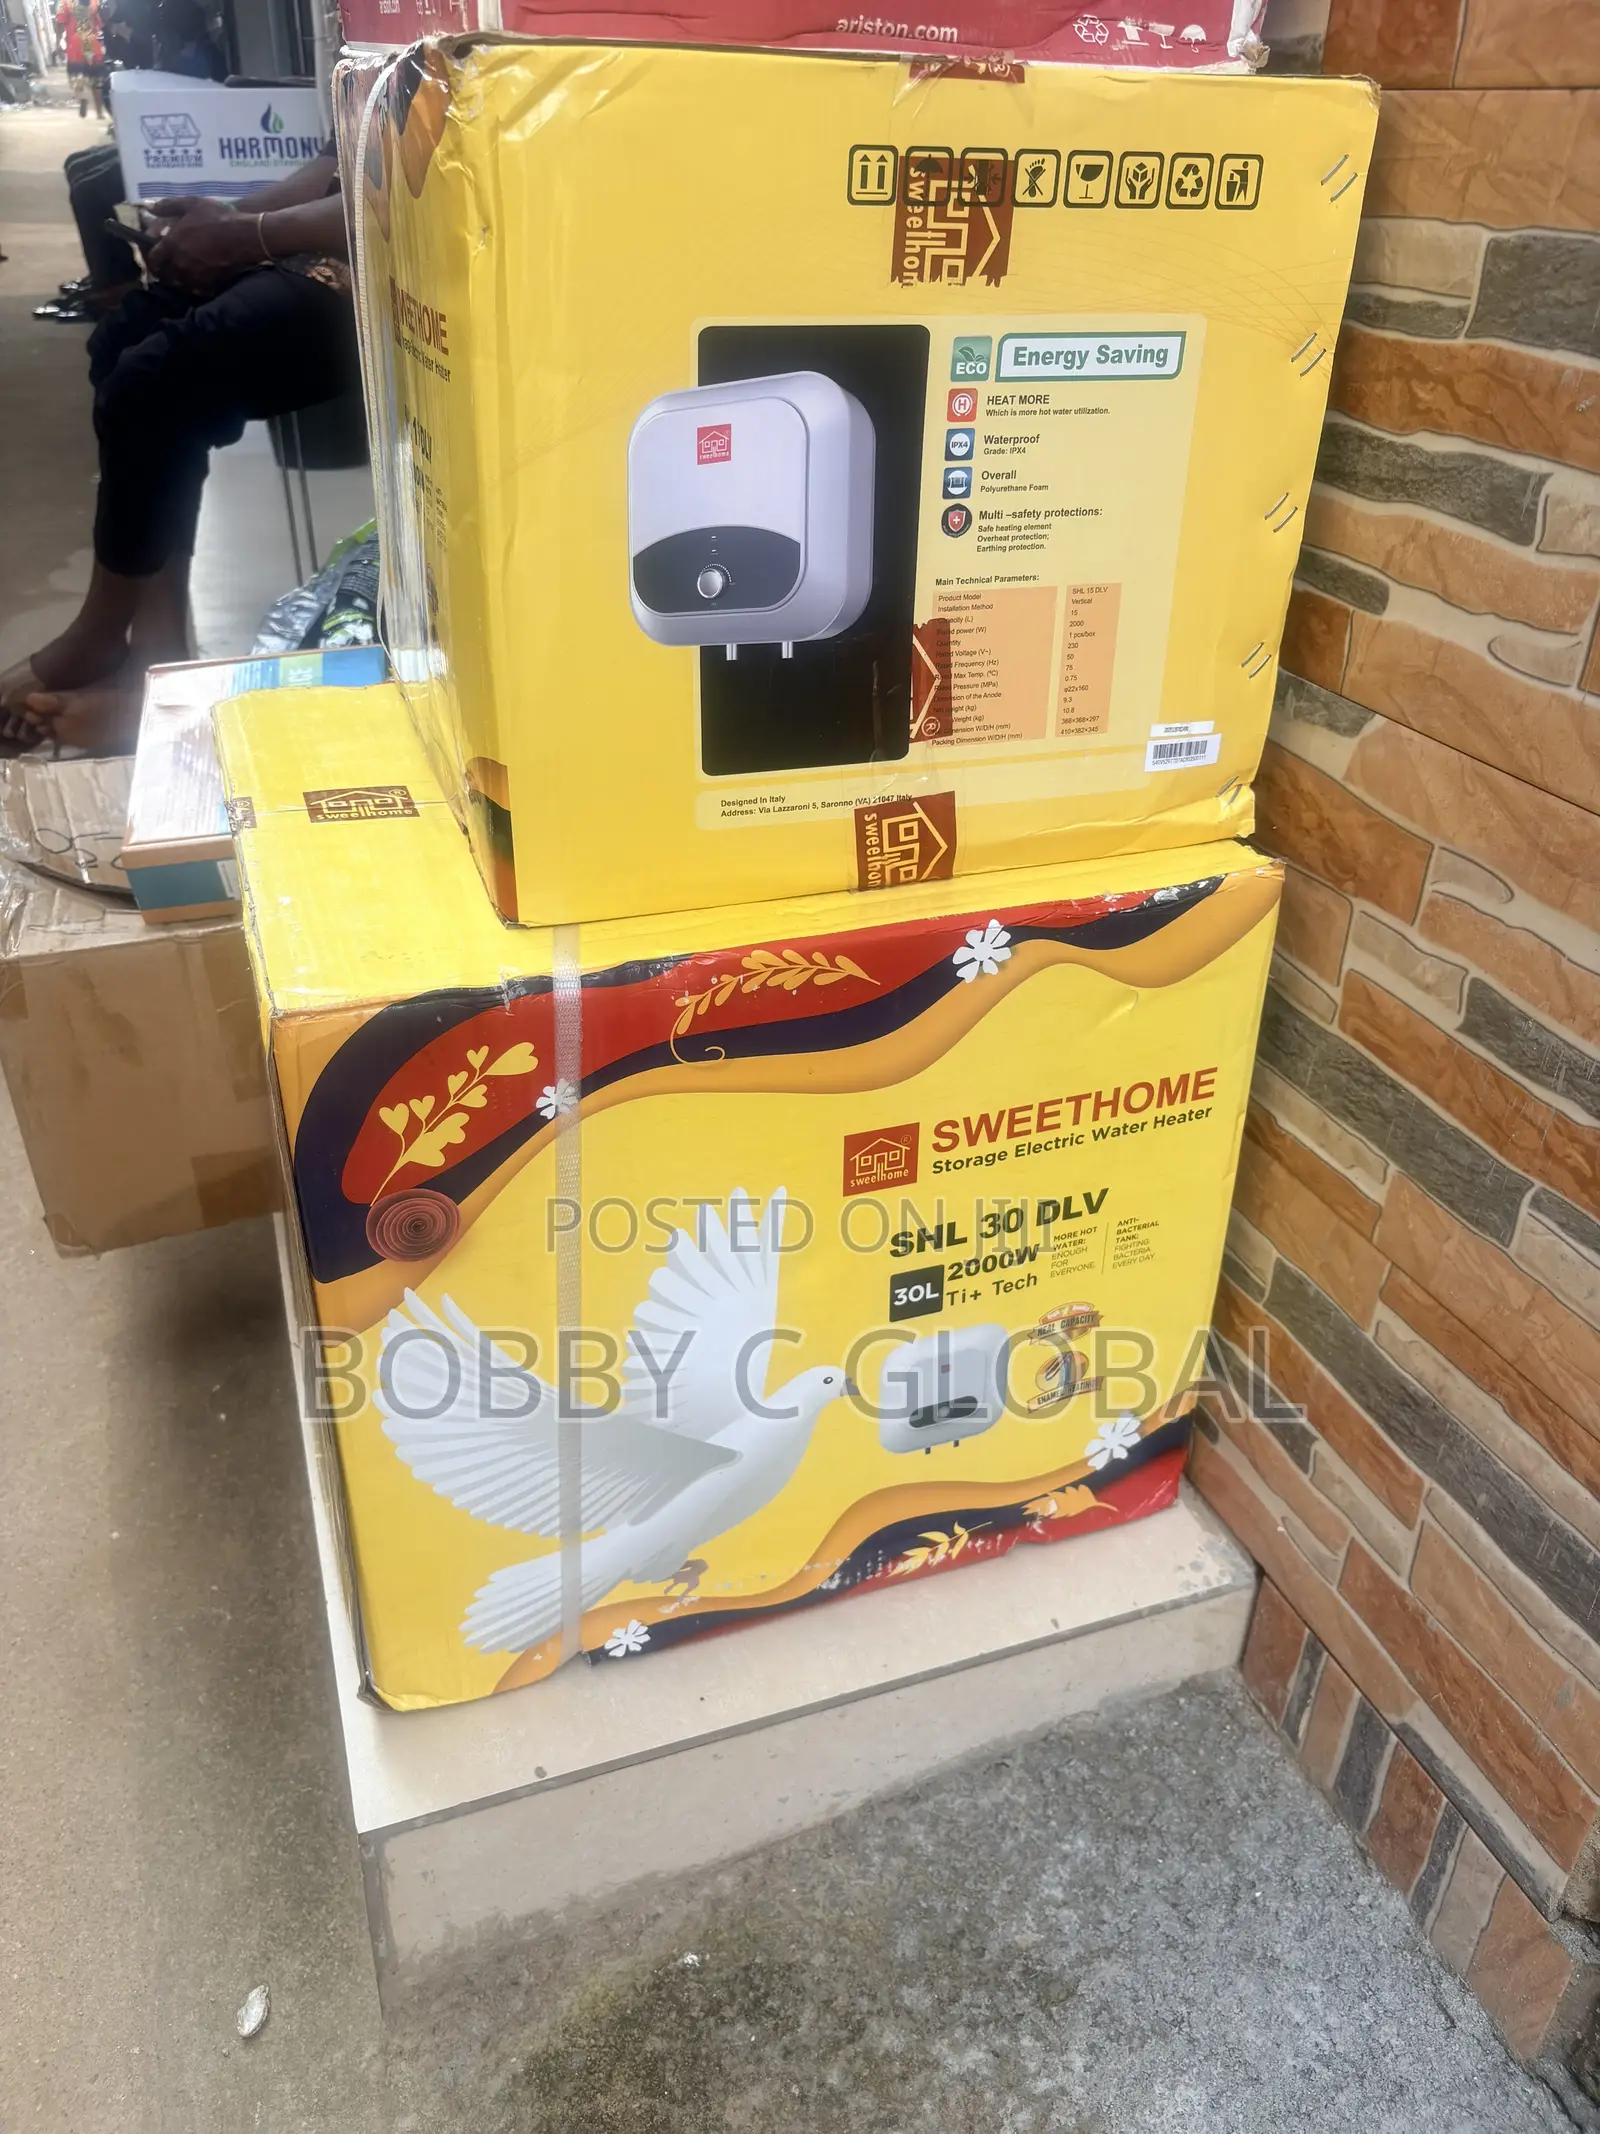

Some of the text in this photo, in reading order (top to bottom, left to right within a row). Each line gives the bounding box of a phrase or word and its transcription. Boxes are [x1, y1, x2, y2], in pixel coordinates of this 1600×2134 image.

[836, 15, 958, 43] ariston.com
[1013, 344, 1169, 370] Energy Saving
[956, 362, 987, 375] ECO
[987, 394, 1050, 406] HEAT MORE
[985, 408, 1009, 417] Which
[1011, 408, 1017, 416] is
[1038, 408, 1051, 416] hot
[1074, 407, 1110, 415] utilization.
[951, 440, 968, 449] IPX4
[984, 434, 1040, 445] Waterproof
[983, 446, 1026, 455] Grade: IPX4
[981, 470, 1017, 480] Overall
[980, 485, 1027, 493] Polyurethane
[979, 510, 1003, 520] Multi
[1044, 507, 1103, 519] protections:
[995, 524, 1022, 533] heating
[1023, 523, 1052, 531] element
[977, 535, 1010, 543] Overheat
[977, 543, 1046, 553] Earthing protection.
[935, 574, 1039, 586] Main Technical Parameters:
[938, 594, 962, 602] Product
[938, 604, 970, 612] Installation
[976, 626, 986, 634] (W)
[1073, 631, 1096, 639] pcs/box
[965, 704, 977, 712] (kg)
[721, 798, 758, 808] Designed
[769, 795, 786, 804] Italy
[721, 808, 756, 818] Address:
[772, 803, 810, 813] Lazzaroni
[812, 803, 819, 811] 5,
[821, 800, 853, 809] Saronno
[855, 797, 871, 807] (VA)
[896, 794, 913, 803] Italy
[932, 1066, 1218, 1153] SWEETHOME
[932, 1106, 1213, 1175] Storage Electric Water Heater
[889, 1188, 1110, 1257] SHL 30 DLV
[1116, 1221, 1159, 1235] BACTERIAL
[1117, 1217, 1139, 1227] ANTI-
[1053, 1226, 1098, 1242] MORE HOT
[1115, 1233, 1139, 1243] TANK:
[1053, 1239, 1086, 1251] WATER:
[1114, 1239, 1150, 1252] FIGHTING
[1051, 1246, 1088, 1260] ENOUGH
[1113, 1247, 1151, 1261] BACTERIA
[946, 1243, 1040, 1282] 2000W
[1051, 1259, 1069, 1269] FOR
[1112, 1257, 1138, 1269] EVERY
[893, 1282, 940, 1307] 30L
[946, 1273, 1038, 1307] Ti+ Tech
[1037, 1313, 1096, 1336] REAL CAPACITY
